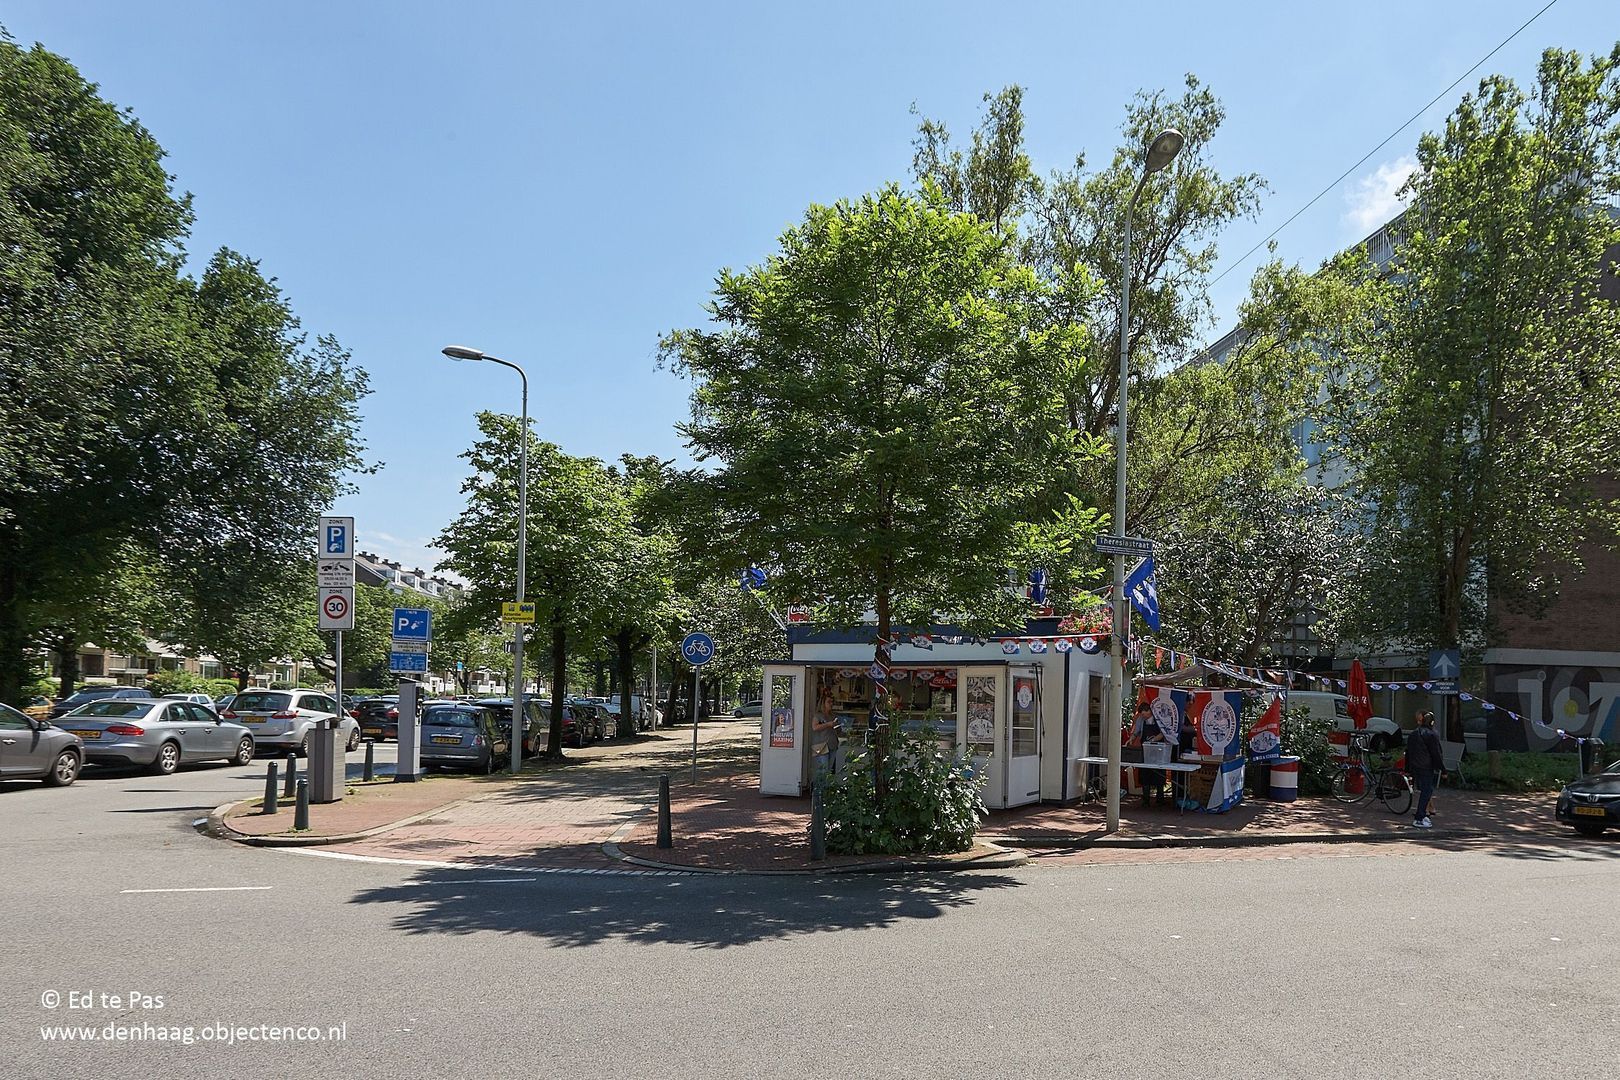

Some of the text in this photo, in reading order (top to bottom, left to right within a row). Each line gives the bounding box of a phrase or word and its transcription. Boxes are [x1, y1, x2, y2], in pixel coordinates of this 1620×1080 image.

[331, 527, 342, 542] P
[1099, 537, 1150, 549] Theresiastraat
[328, 602, 344, 612] 30
[398, 617, 409, 631] P
